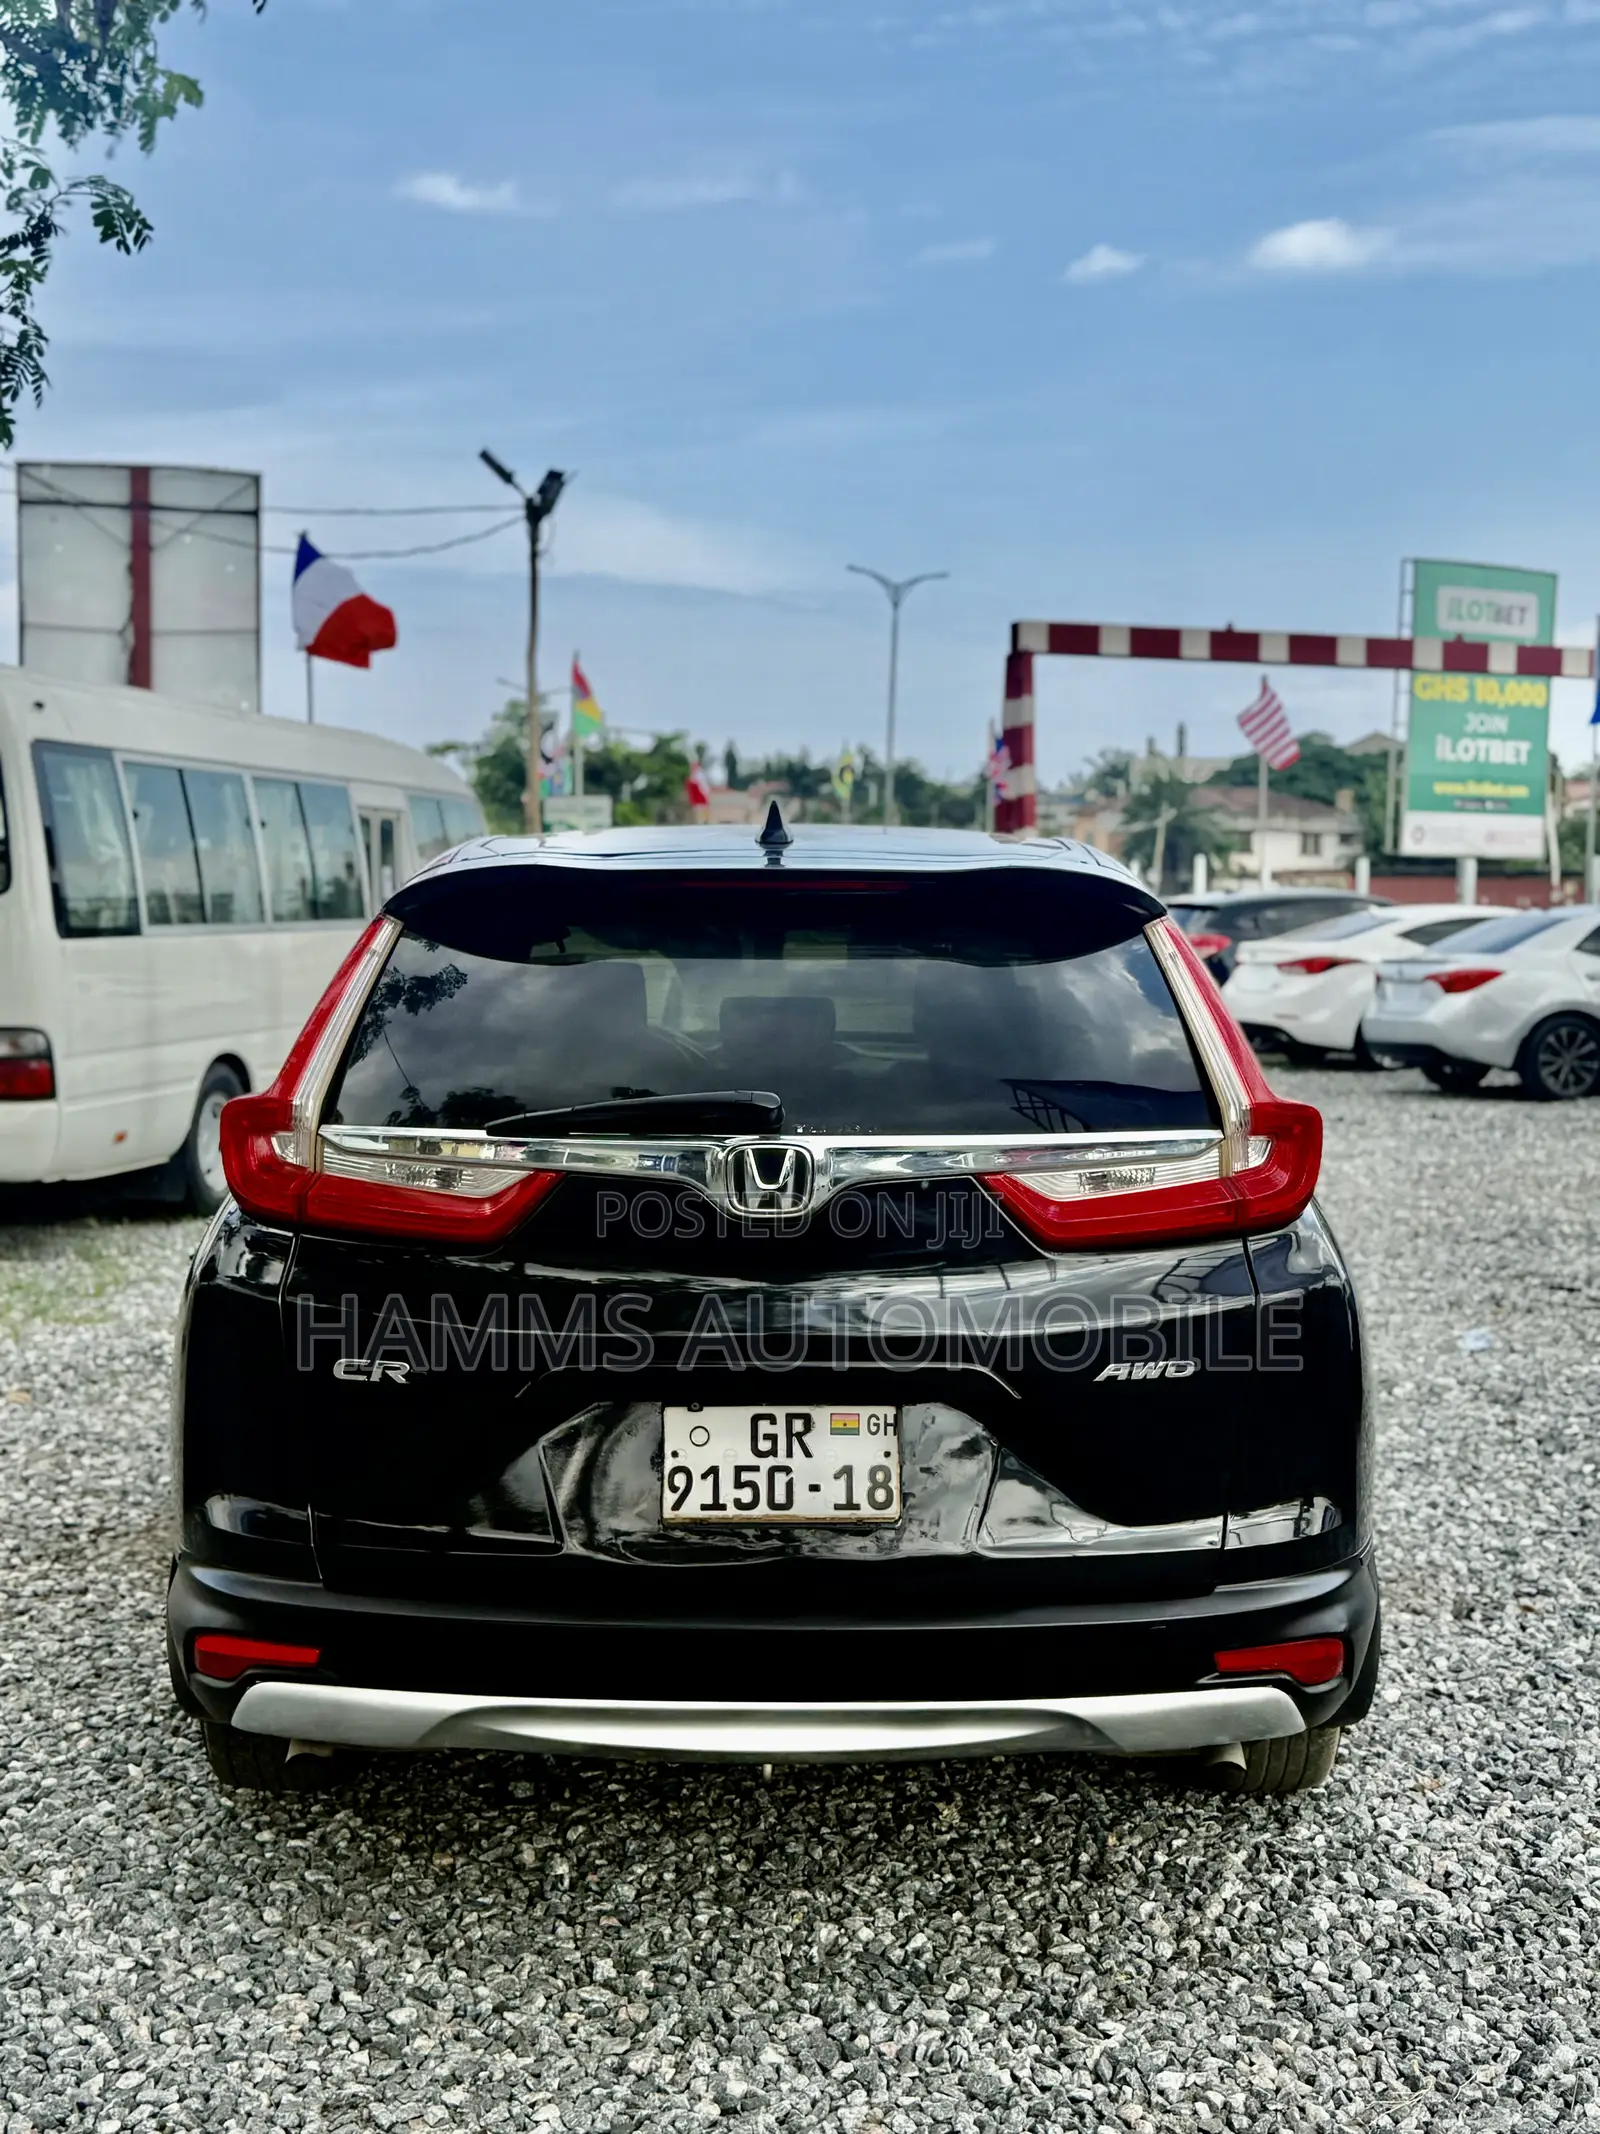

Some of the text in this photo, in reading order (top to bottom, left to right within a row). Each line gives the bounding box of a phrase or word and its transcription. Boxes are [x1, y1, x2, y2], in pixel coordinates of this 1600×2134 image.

[1413, 674, 1547, 709] GHS 10,000
[1464, 711, 1508, 734] JOIN
[1093, 1361, 1195, 1382] AWD
[750, 1413, 813, 1458] GR
[866, 1413, 897, 1436] GH
